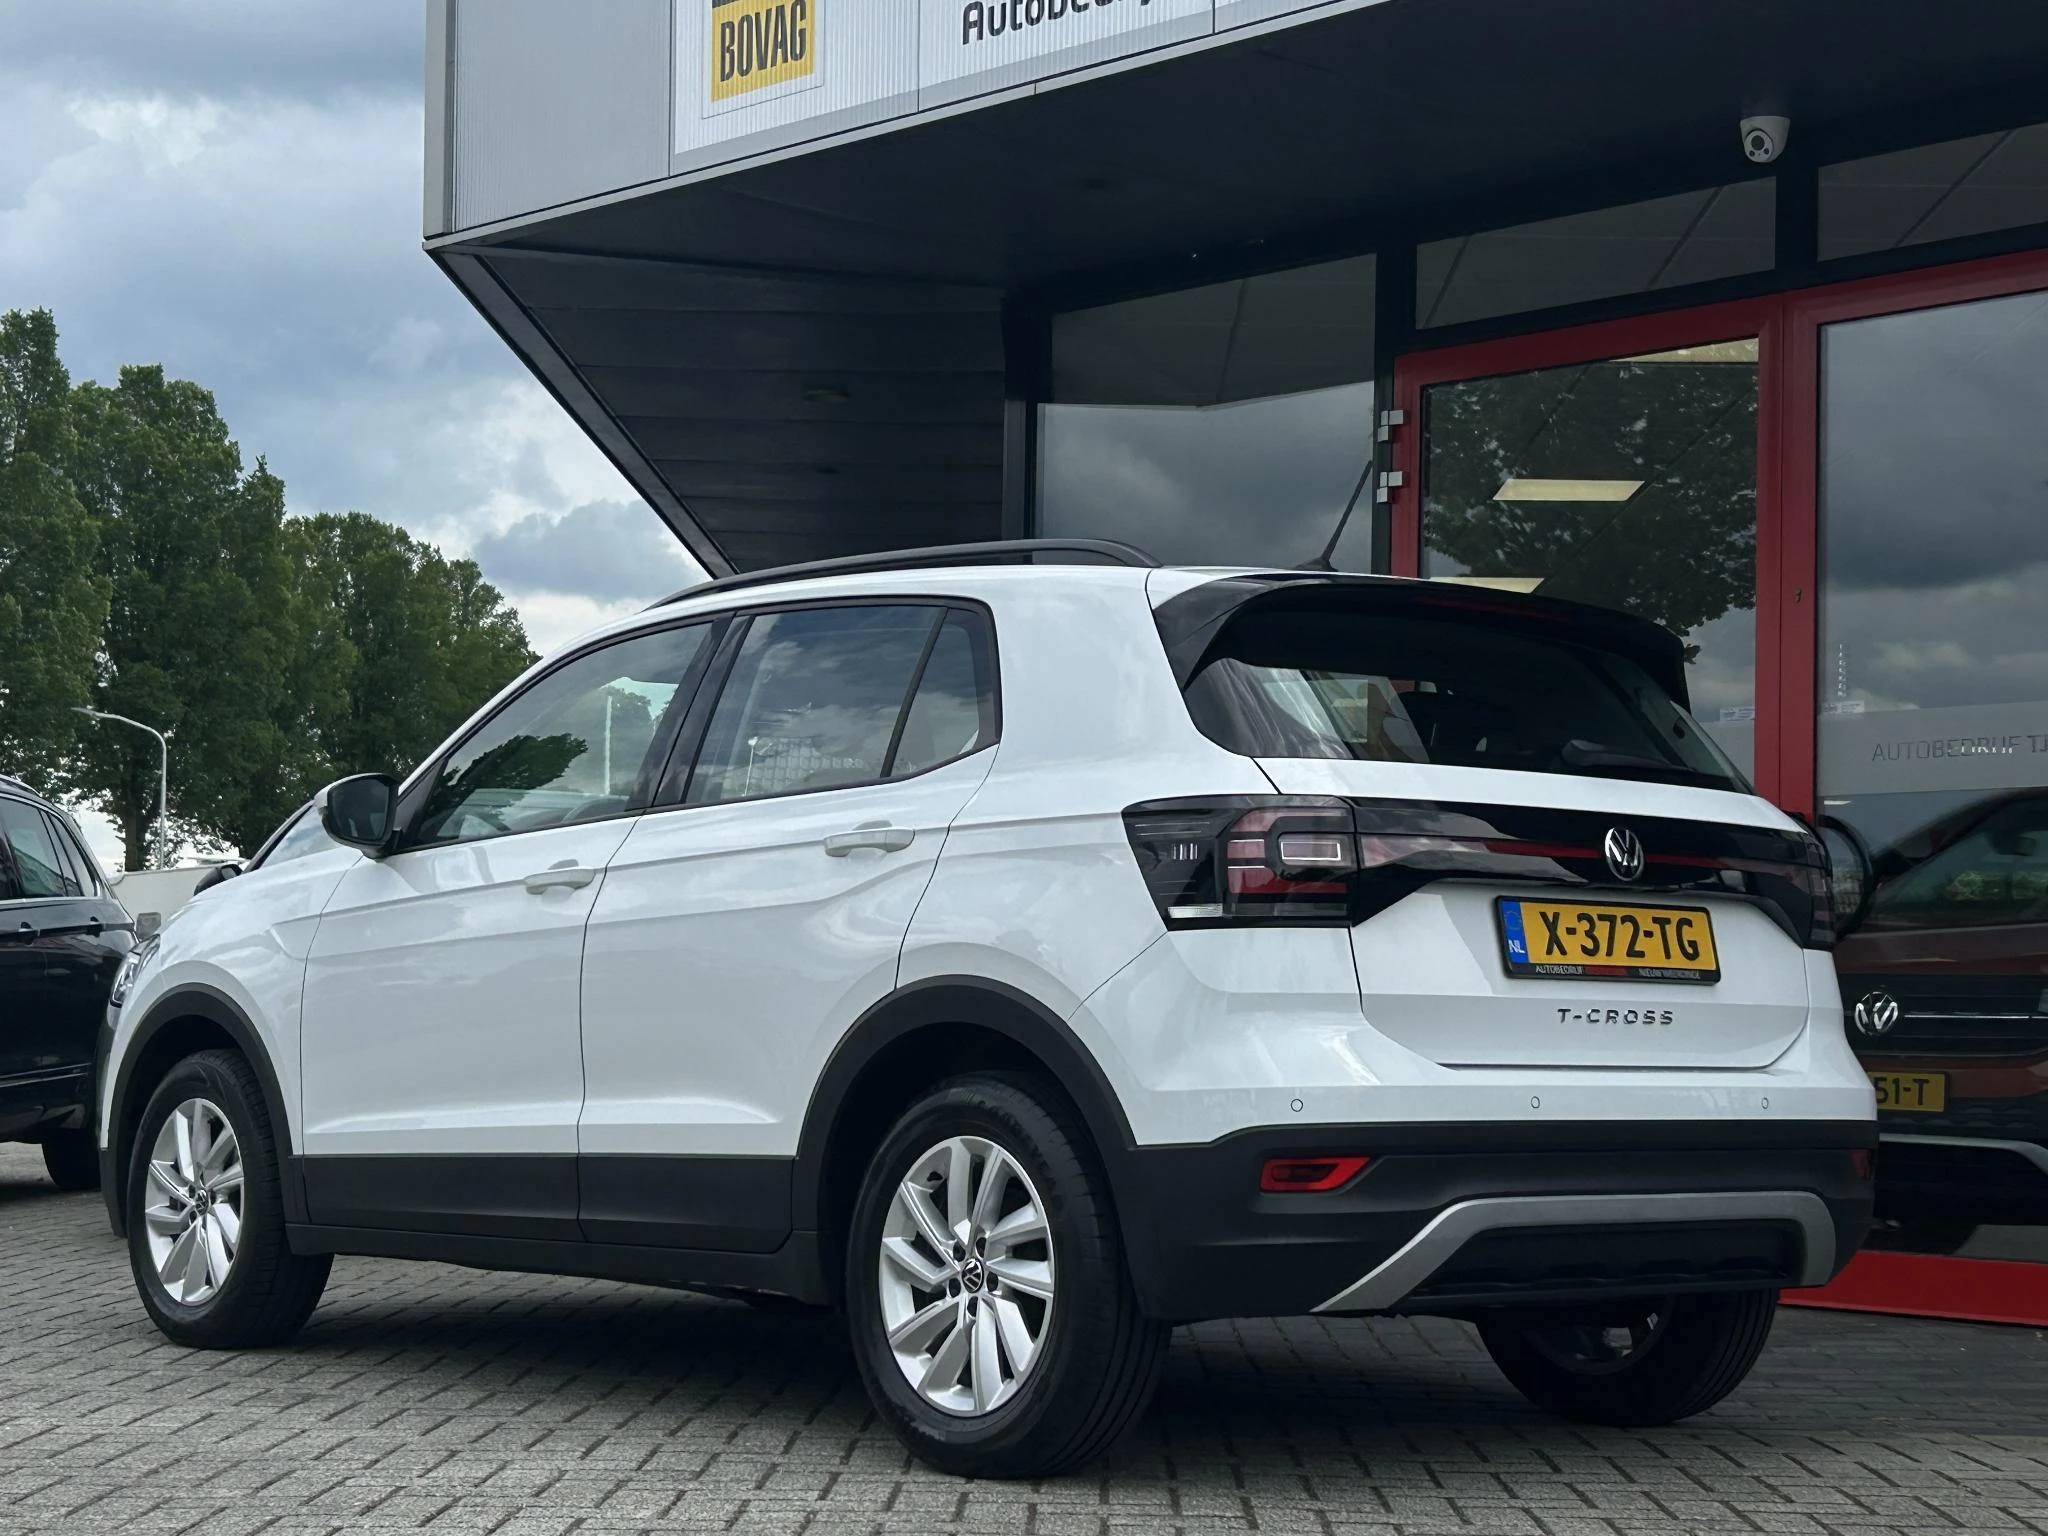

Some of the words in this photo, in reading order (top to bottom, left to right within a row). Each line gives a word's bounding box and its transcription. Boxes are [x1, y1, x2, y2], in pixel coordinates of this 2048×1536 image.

[720, 0, 807, 82] BOVAG
[1508, 939, 1526, 955] NL
[1539, 911, 1701, 961] X-372-TG
[1557, 1008, 1674, 1026] T-CROSS
